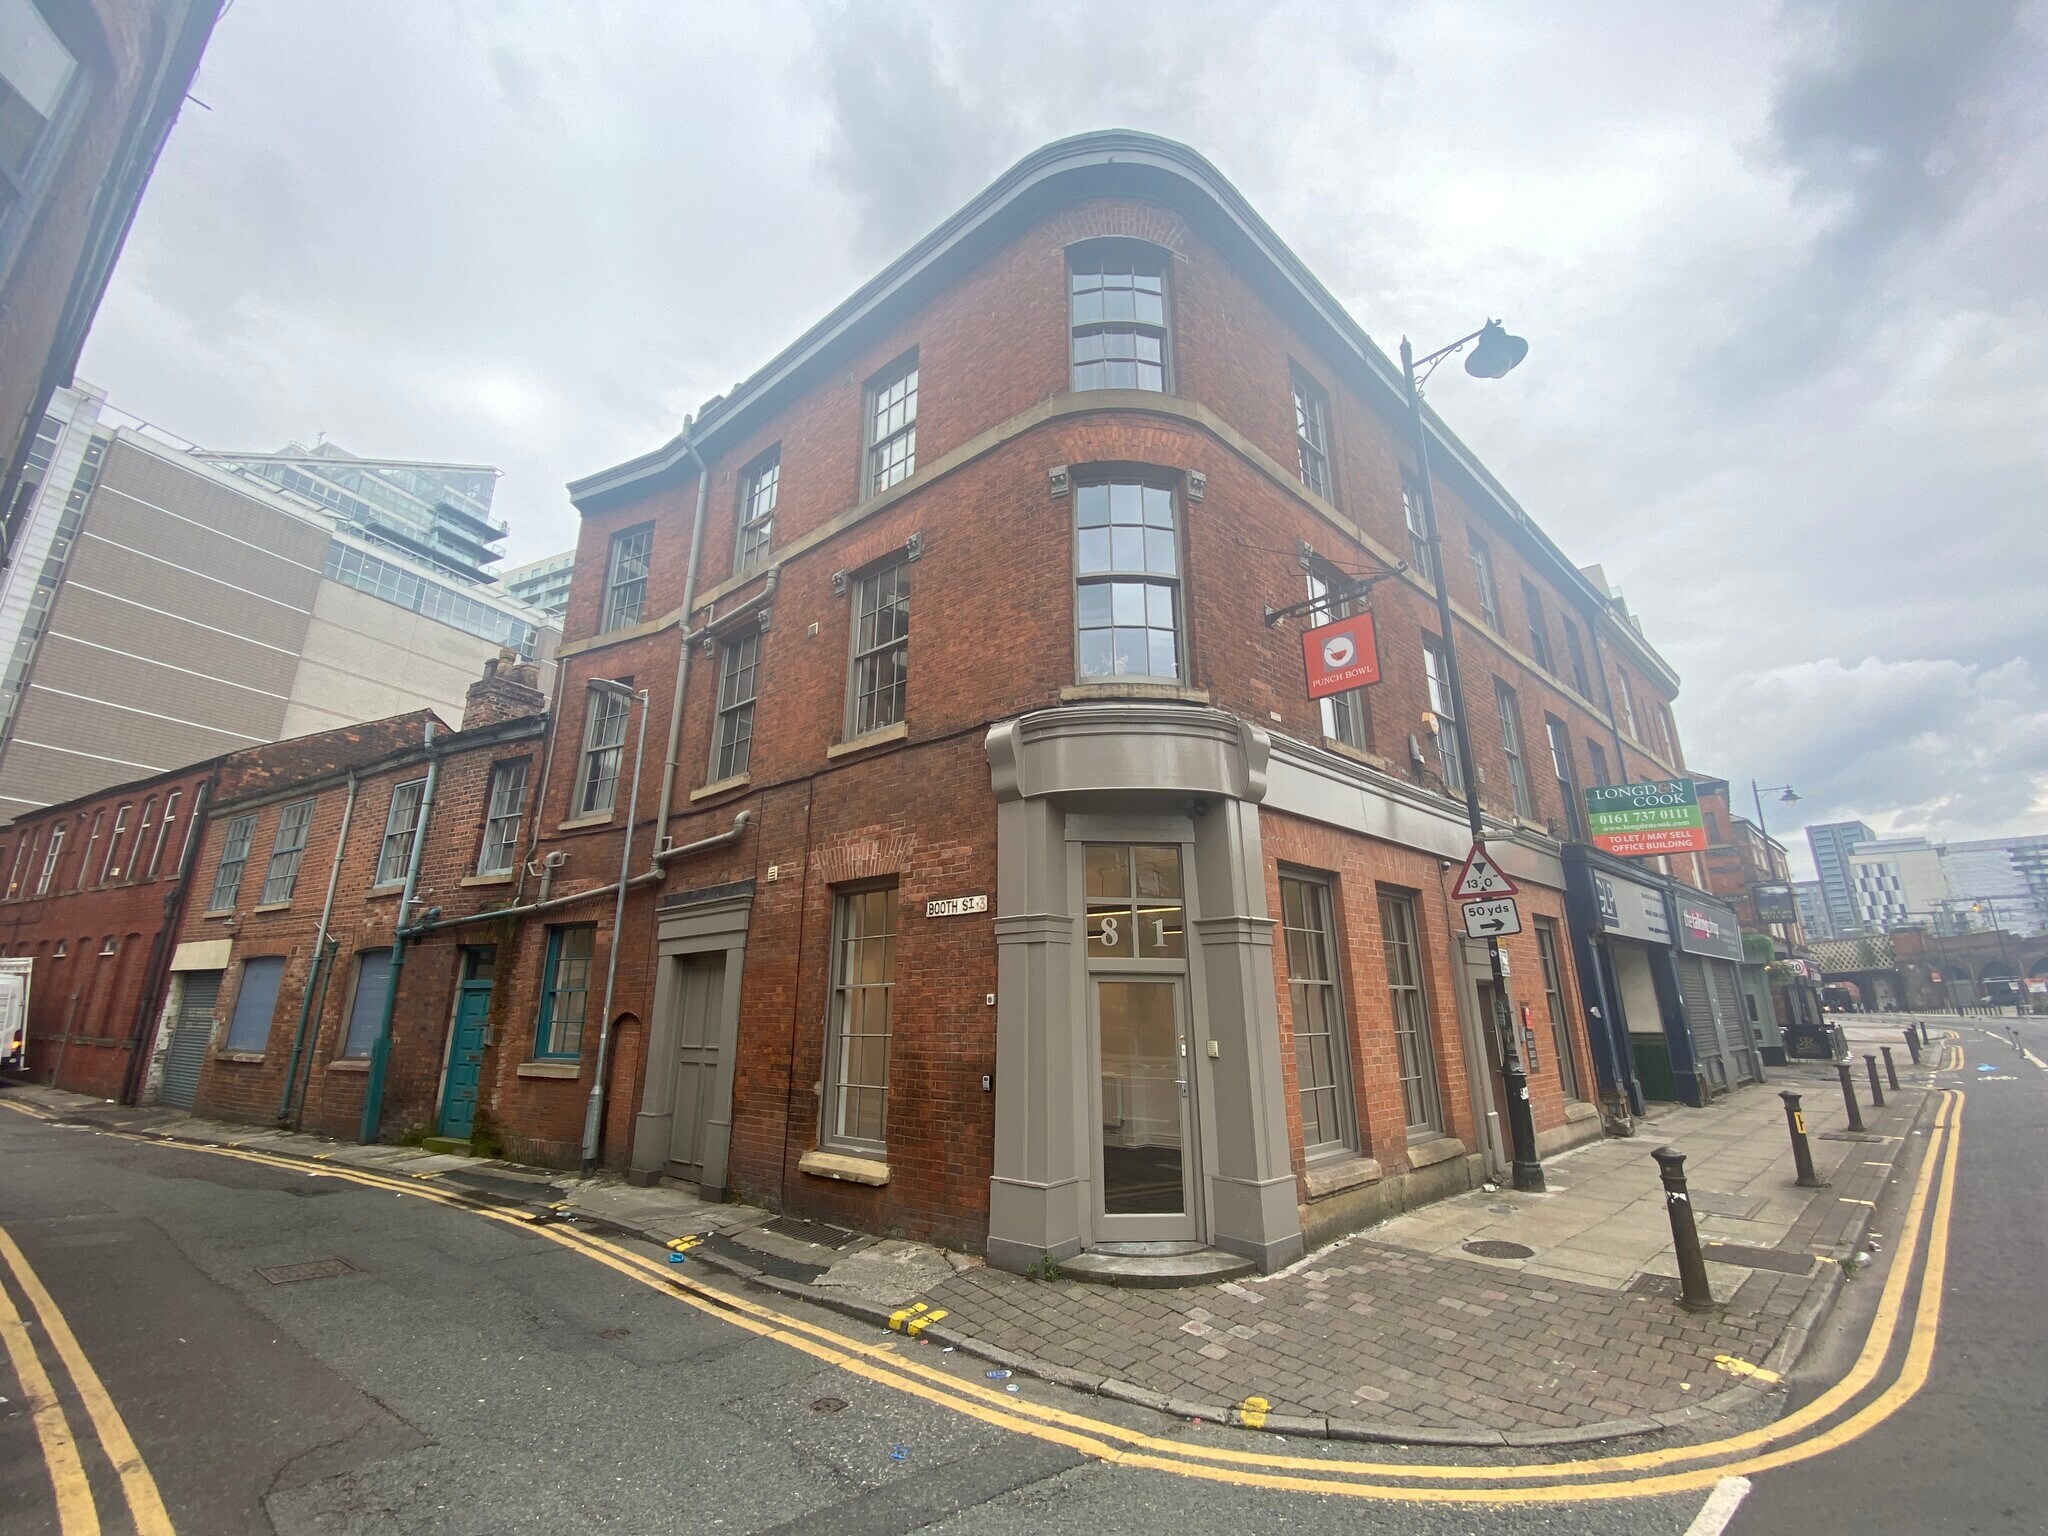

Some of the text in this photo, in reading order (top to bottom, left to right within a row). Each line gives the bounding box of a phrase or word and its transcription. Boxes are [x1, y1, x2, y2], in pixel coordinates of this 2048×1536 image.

[1312, 666, 1373, 687] PUNCH BOWL
[1595, 782, 1684, 800] LONGDEN
[1633, 793, 1686, 807] COOK
[1599, 808, 1689, 825] 0161 737 0111
[1602, 820, 1690, 832] www.longdencook.com
[1609, 836, 1622, 844] TO
[1623, 834, 1640, 842] LET
[1647, 832, 1668, 841] MAY
[1669, 830, 1692, 839] SELL
[1612, 839, 1693, 852] OFFICE BUILDING
[928, 900, 958, 915] BOOTH
[1468, 904, 1510, 917] 50 yds
